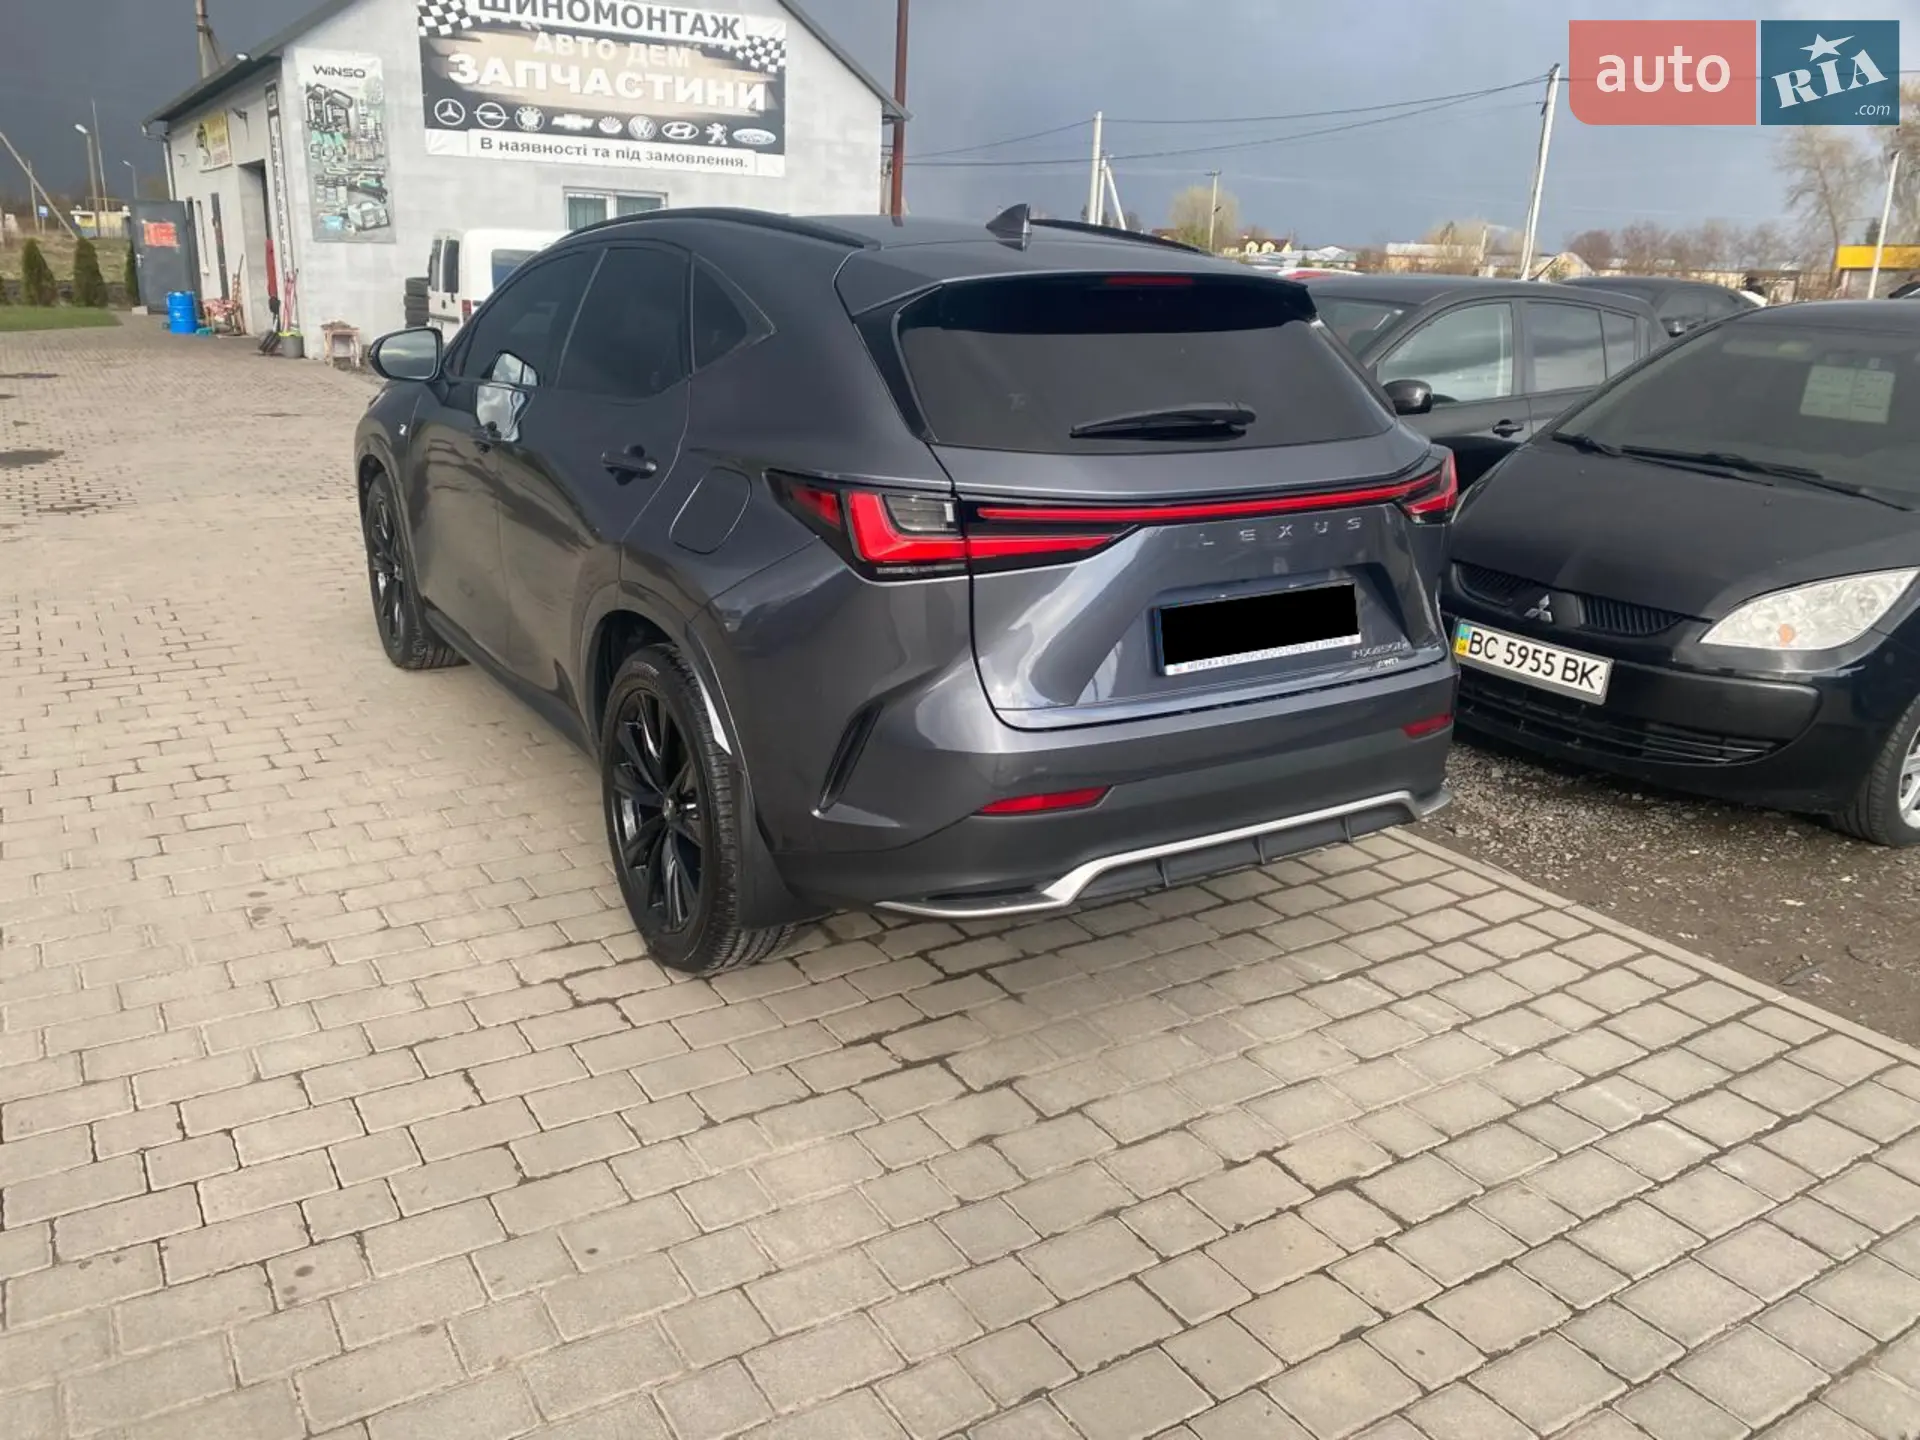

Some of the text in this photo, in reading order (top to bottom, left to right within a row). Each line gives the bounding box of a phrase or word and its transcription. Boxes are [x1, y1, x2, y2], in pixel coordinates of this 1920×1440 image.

[479, 0, 740, 40] ШИНОМОНТАЖ
[533, 31, 691, 68] АВТО ДЕМ
[448, 53, 766, 111] ЗАПЧАСТИНИ
[480, 137, 493, 150] В
[499, 141, 588, 157] наявності
[592, 147, 610, 159] та
[615, 147, 641, 161] під
[1200, 516, 1362, 547] LEXUS
[1468, 631, 1599, 689] BC 5955 BK
